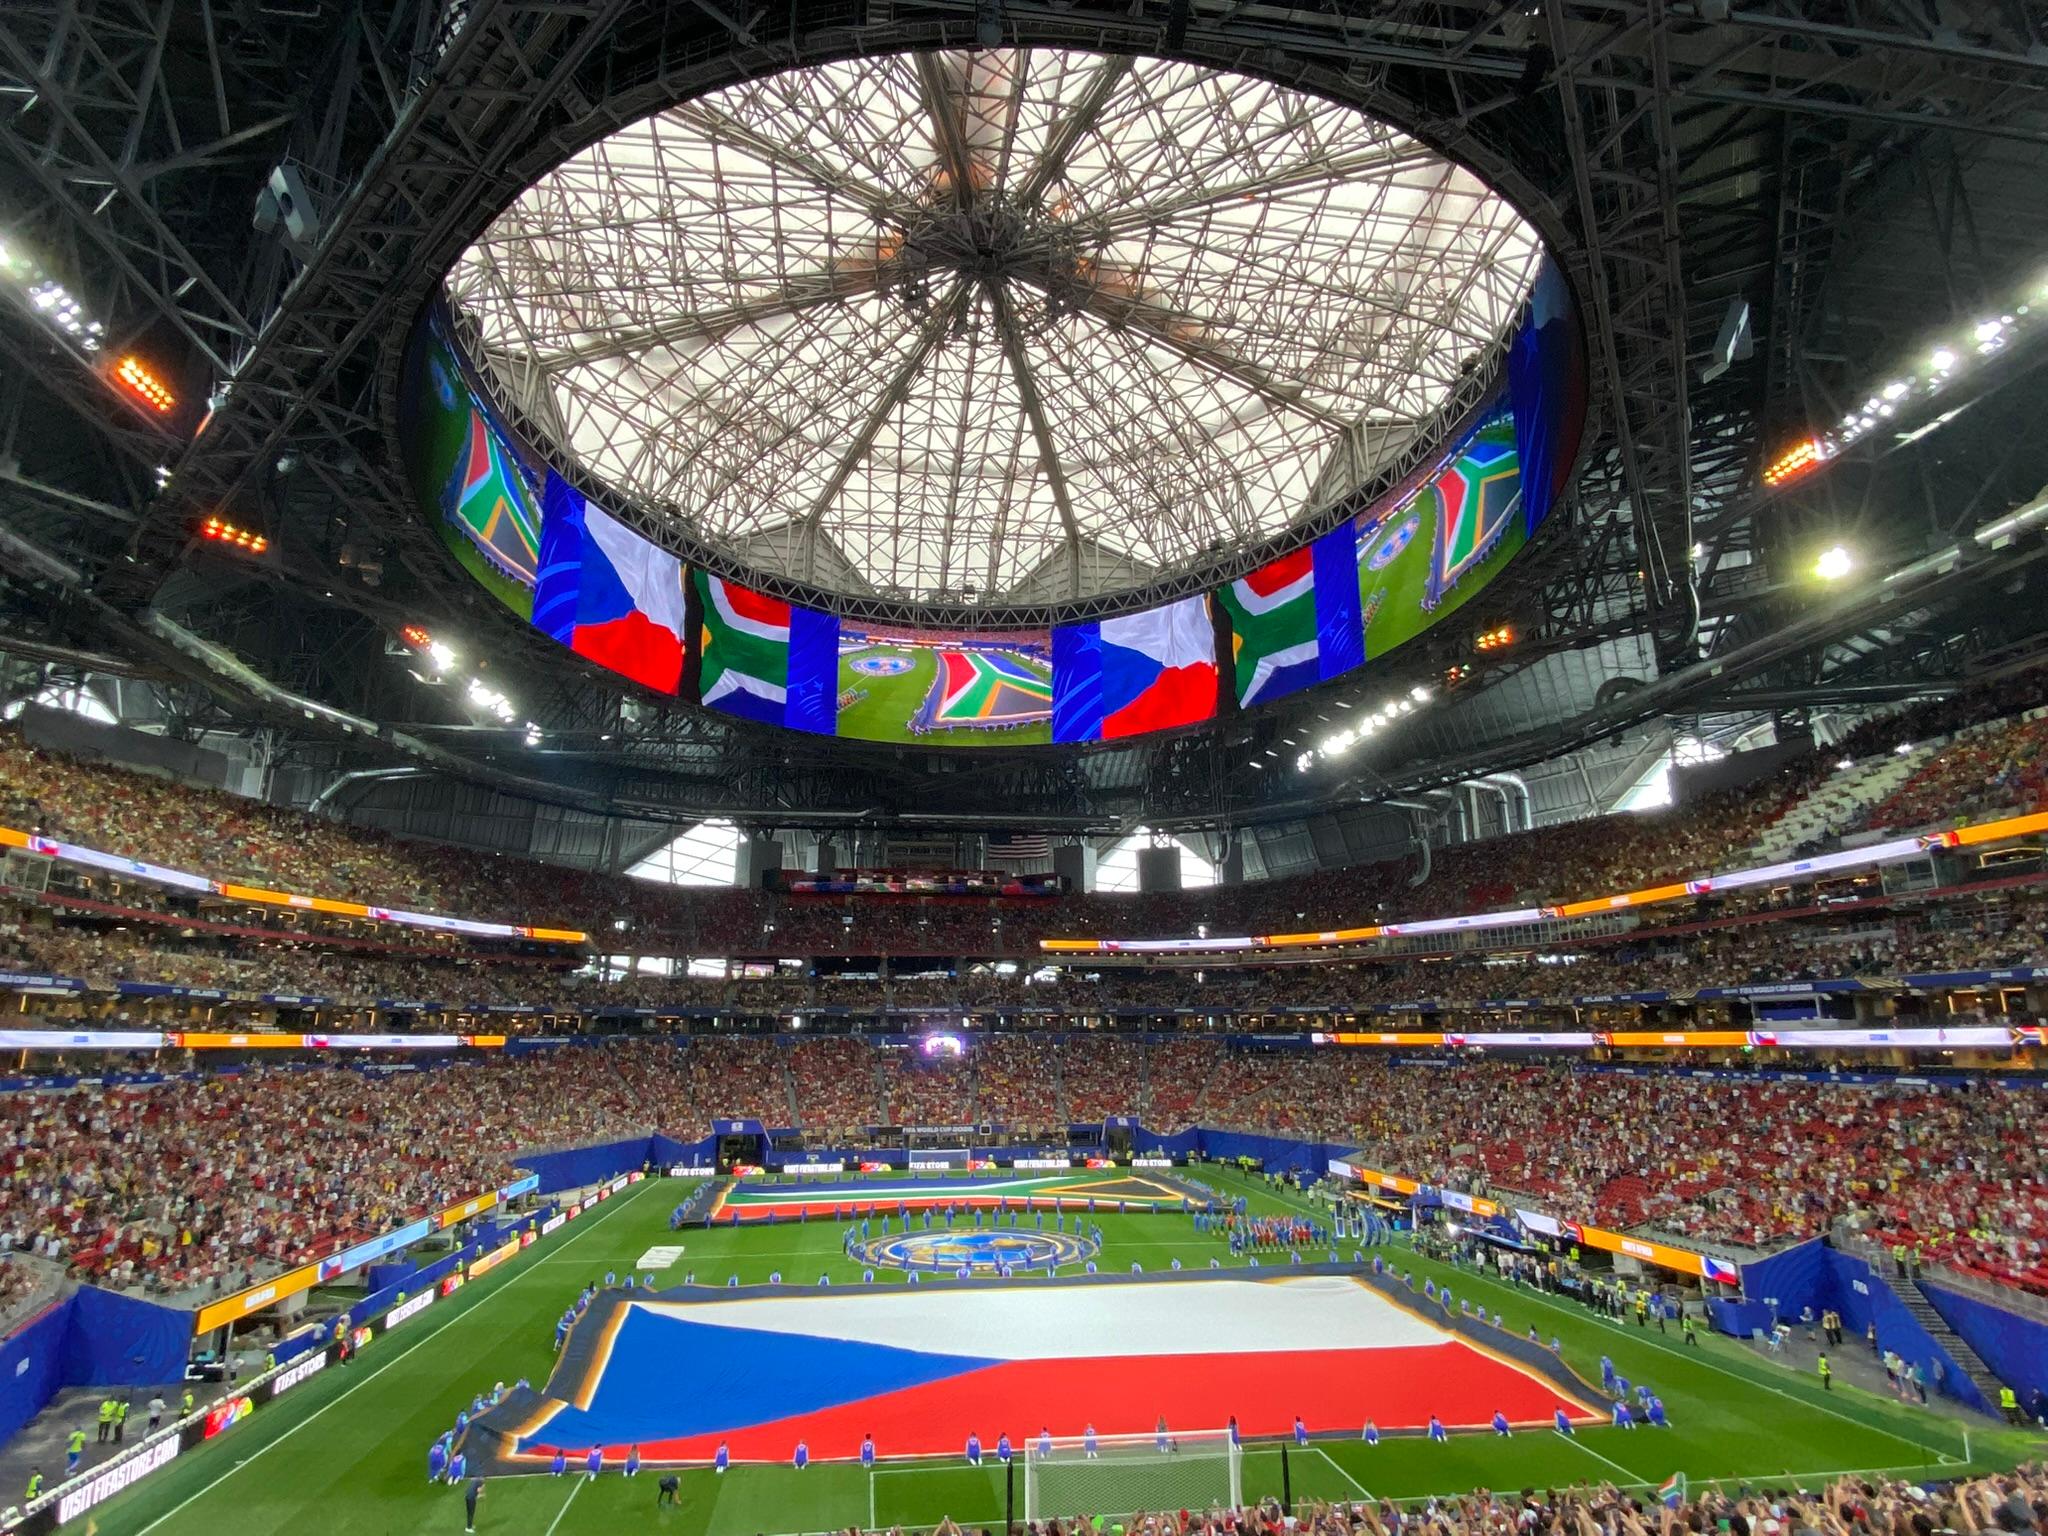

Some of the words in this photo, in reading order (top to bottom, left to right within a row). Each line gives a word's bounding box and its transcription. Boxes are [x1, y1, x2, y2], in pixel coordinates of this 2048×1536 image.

[671, 1168, 688, 1176] FIFA
[272, 1365, 297, 1395] FIFA
[296, 1351, 327, 1381] STORE
[59, 1480, 95, 1524] VISIT
[92, 1433, 180, 1504] FIFASTORE.COM
